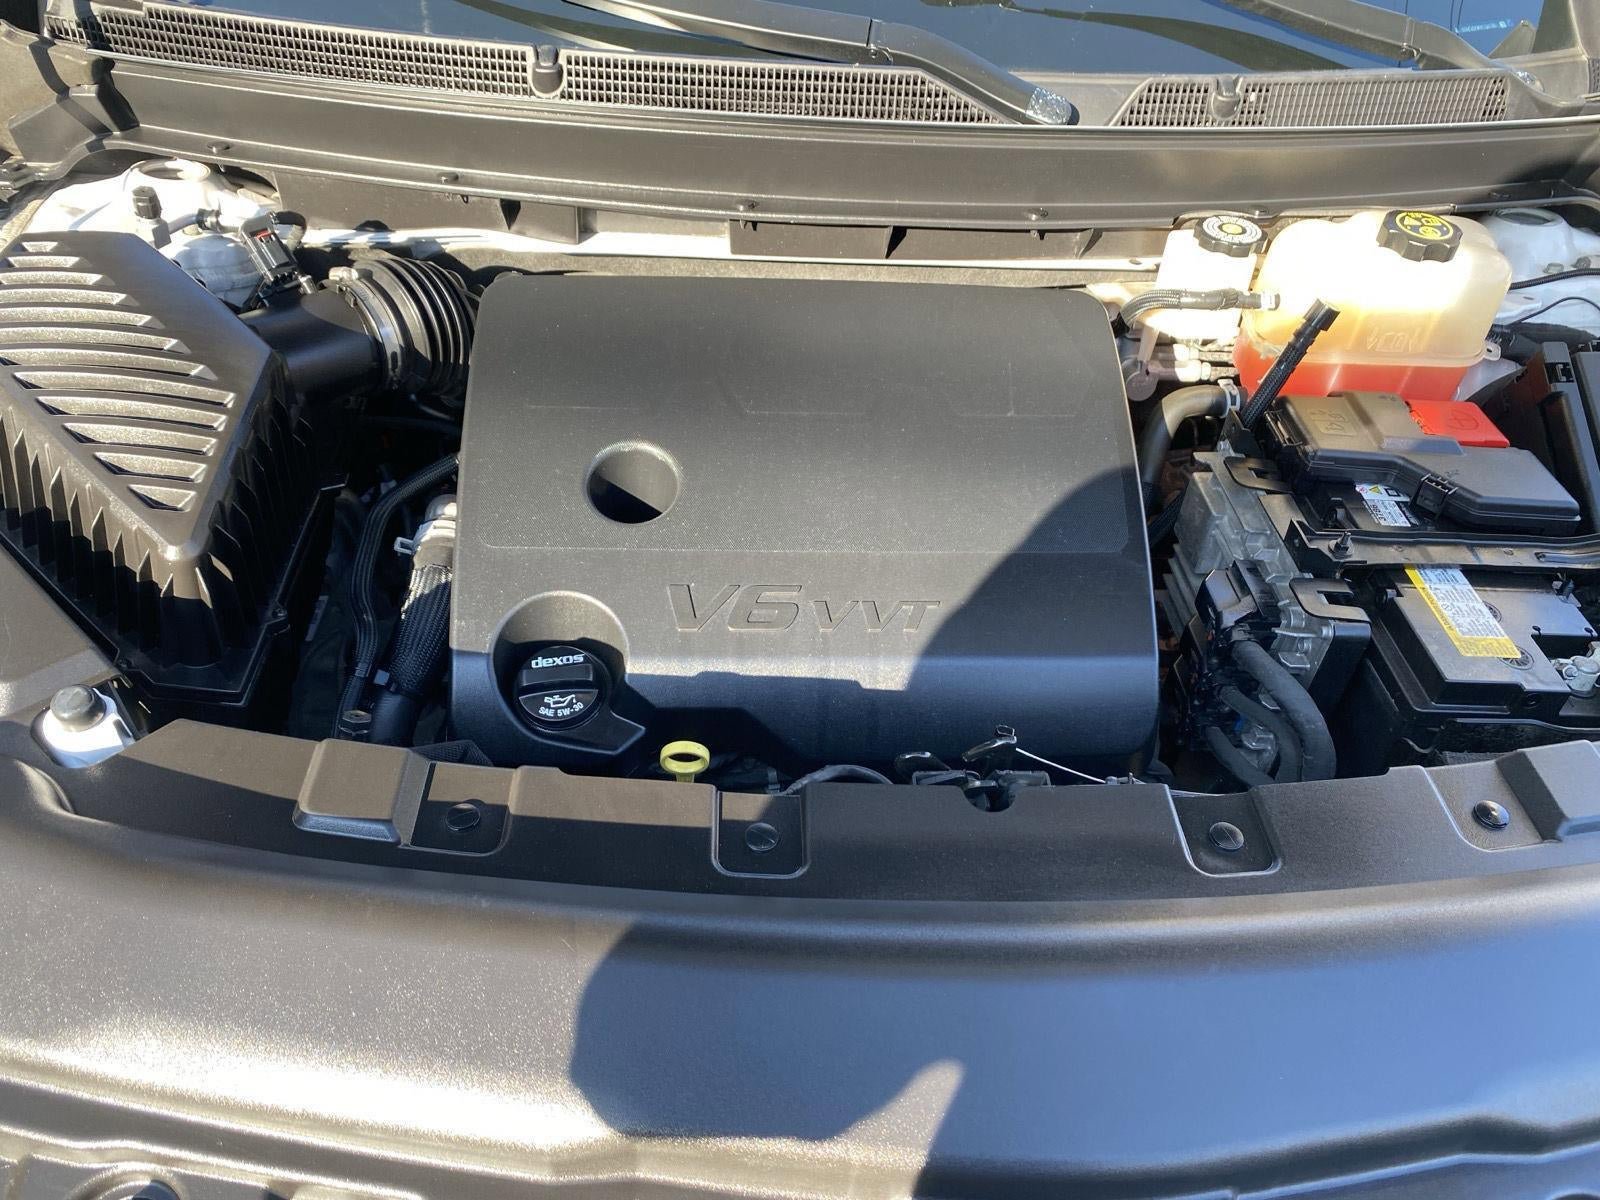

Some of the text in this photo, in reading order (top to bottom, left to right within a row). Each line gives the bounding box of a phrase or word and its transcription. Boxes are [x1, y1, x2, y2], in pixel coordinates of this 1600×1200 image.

[667, 583, 941, 633] V6 VVT
[531, 654, 584, 669] dexos
[538, 702, 584, 717] SAE 5W-30
